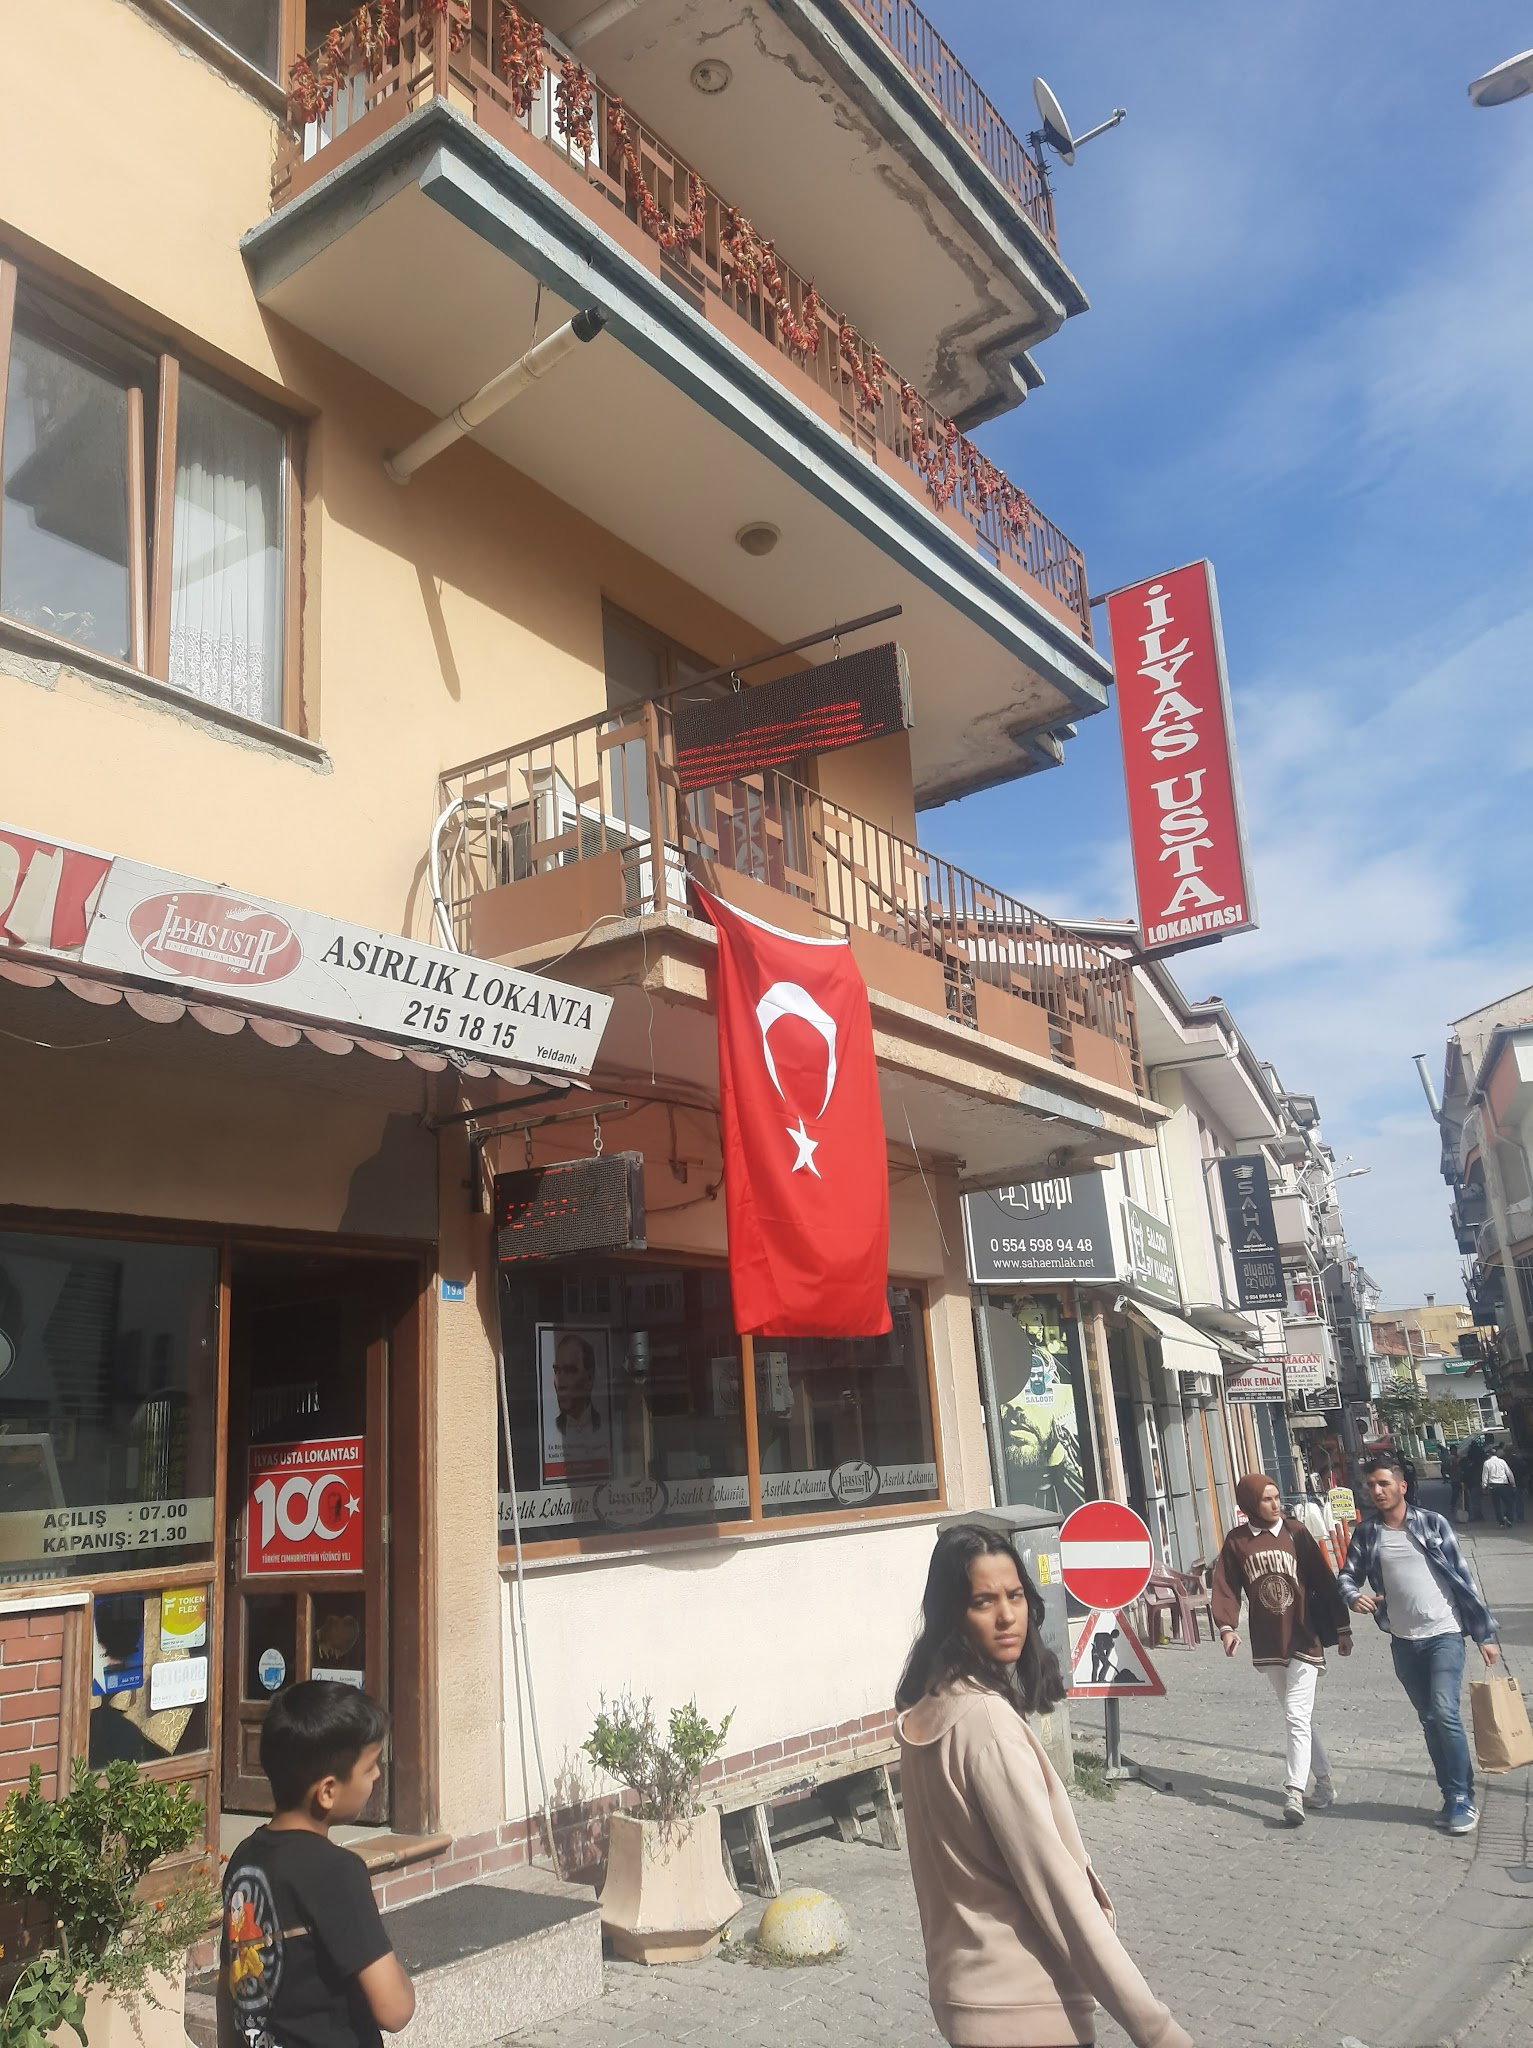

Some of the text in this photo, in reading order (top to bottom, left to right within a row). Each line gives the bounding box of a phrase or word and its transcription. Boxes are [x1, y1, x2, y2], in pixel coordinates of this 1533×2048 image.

[1136, 584, 1225, 917] İLYAS USTA
[1147, 904, 1243, 944] LOKANTASI
[320, 935, 593, 1030] ASIRLIK LOKANTA
[404, 1000, 517, 1049] 215 18 15
[536, 1045, 577, 1065] Yeldanlı
[1237, 1181, 1263, 1242] SAHA
[990, 1238, 1093, 1252] 0 554 598 94 48
[992, 1257, 1096, 1269] www.sahaemlak.net
[1226, 1377, 1254, 1388] DORUK
[1255, 1376, 1282, 1387] EMLAK
[280, 1451, 303, 1465] USTA
[304, 1447, 359, 1463] LOKANTASI
[906, 1470, 934, 1485] Lokanta
[761, 1478, 827, 1499] Asırlık Lokanta
[43, 1509, 107, 1531] AÇILIŞ
[139, 1504, 188, 1521] 07.00
[538, 1497, 589, 1519] Lokanta
[138, 1526, 187, 1544] 21.30
[178, 1595, 205, 1605] TOKEN
[178, 1604, 198, 1614] FLEX
